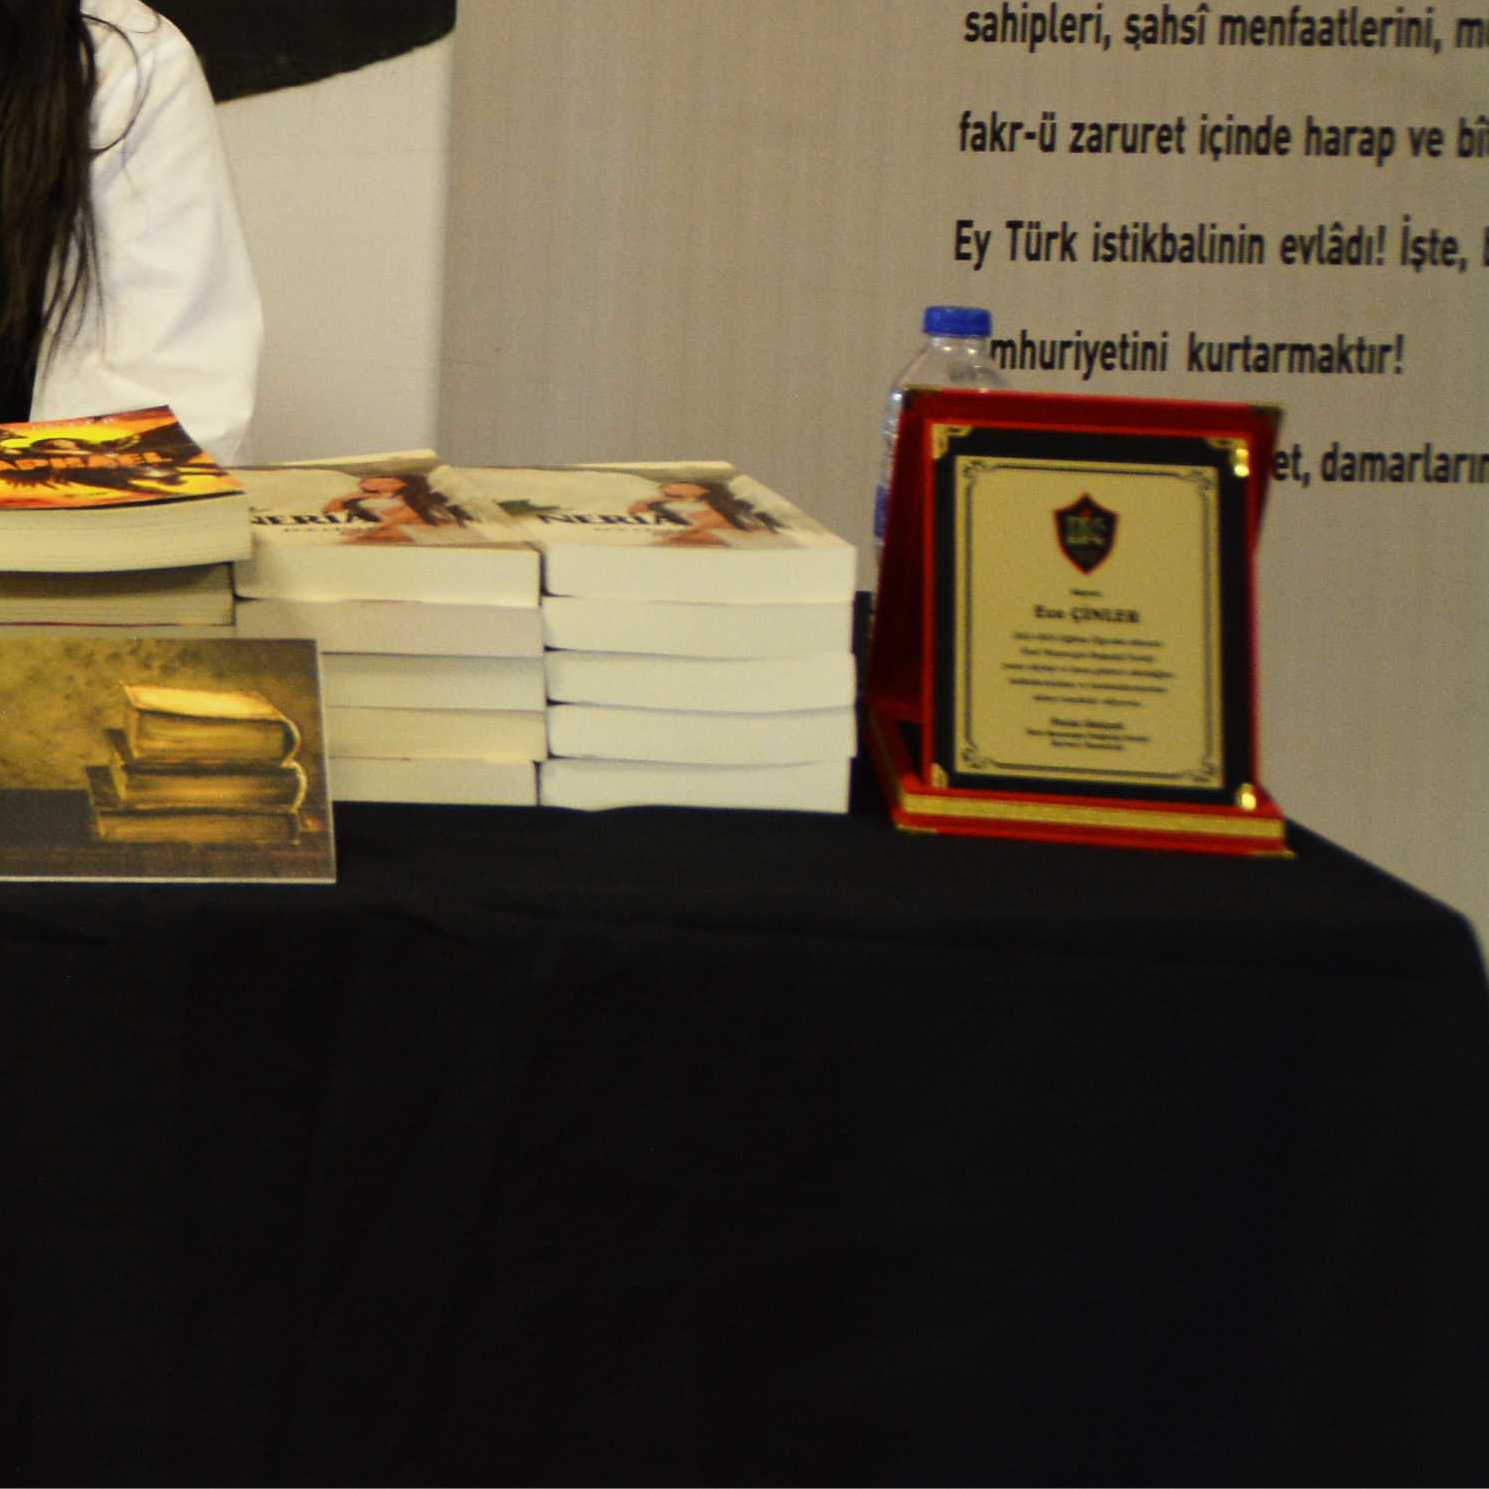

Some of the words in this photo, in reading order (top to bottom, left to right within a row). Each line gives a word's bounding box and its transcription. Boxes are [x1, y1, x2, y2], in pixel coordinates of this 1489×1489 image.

[962, 1, 1113, 54] sahipleri,
[1122, 5, 1212, 51] şahsî
[1217, 5, 1444, 56] menfaatlerini,
[1453, 17, 1489, 50] m
[957, 110, 1059, 154] fakr-ü
[1067, 116, 1188, 156] zaruret
[1198, 113, 1293, 162] içinde
[1302, 114, 1398, 168] harap
[1406, 126, 1446, 159] ve
[953, 219, 994, 273] Ey
[1004, 219, 1079, 264] Türk
[1091, 220, 1266, 266] istikbalinin
[1278, 221, 1388, 267] evlâdı!
[1399, 213, 1470, 274] İşte,
[1185, 331, 1406, 376] kurtarmaktır!
